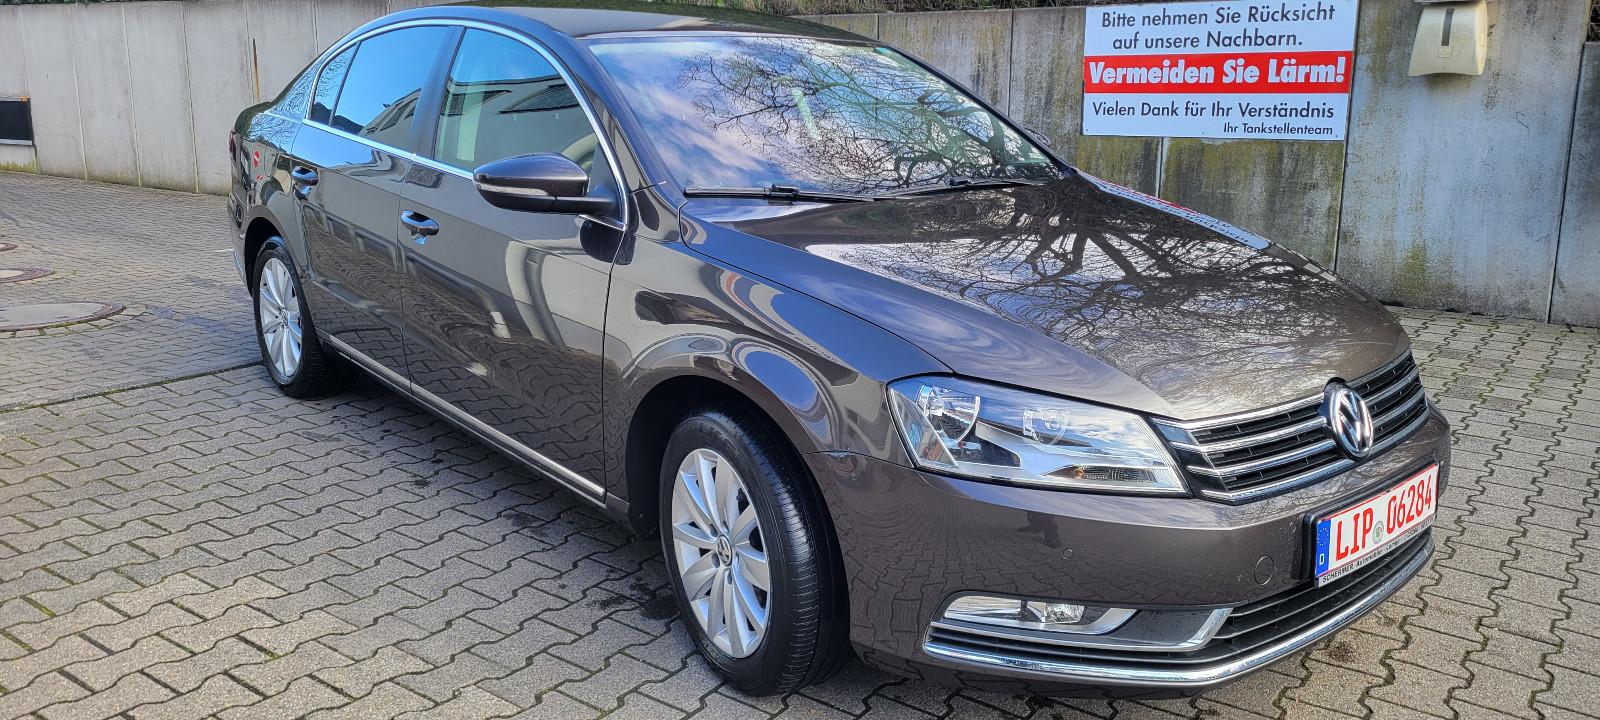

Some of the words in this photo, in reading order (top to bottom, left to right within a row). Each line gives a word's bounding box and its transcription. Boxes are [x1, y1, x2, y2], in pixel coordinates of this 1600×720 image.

[1102, 12, 1135, 27] Bitte
[1142, 8, 1208, 26] nehmen
[1215, 7, 1241, 24] Sie
[1248, 1, 1335, 23] Rücksicht
[1113, 32, 1140, 50] auf
[1145, 32, 1199, 48] unsere
[1207, 29, 1302, 48] Nachbarn.
[1089, 60, 1214, 84] Vermeiden
[1222, 59, 1259, 83] Sie
[1268, 56, 1345, 83] Lärm!
[1093, 102, 1135, 116] Vielen
[1141, 102, 1179, 116] Dank
[1184, 102, 1206, 117] für
[1211, 103, 1232, 117] Ihr
[1238, 101, 1334, 118] Verständnis
[1224, 123, 1238, 134] Ihr
[1242, 123, 1332, 135] Tankstellenteam
[1335, 507, 1374, 562] LIP
[1386, 474, 1432, 534] 06284
[1319, 554, 1325, 566] D
